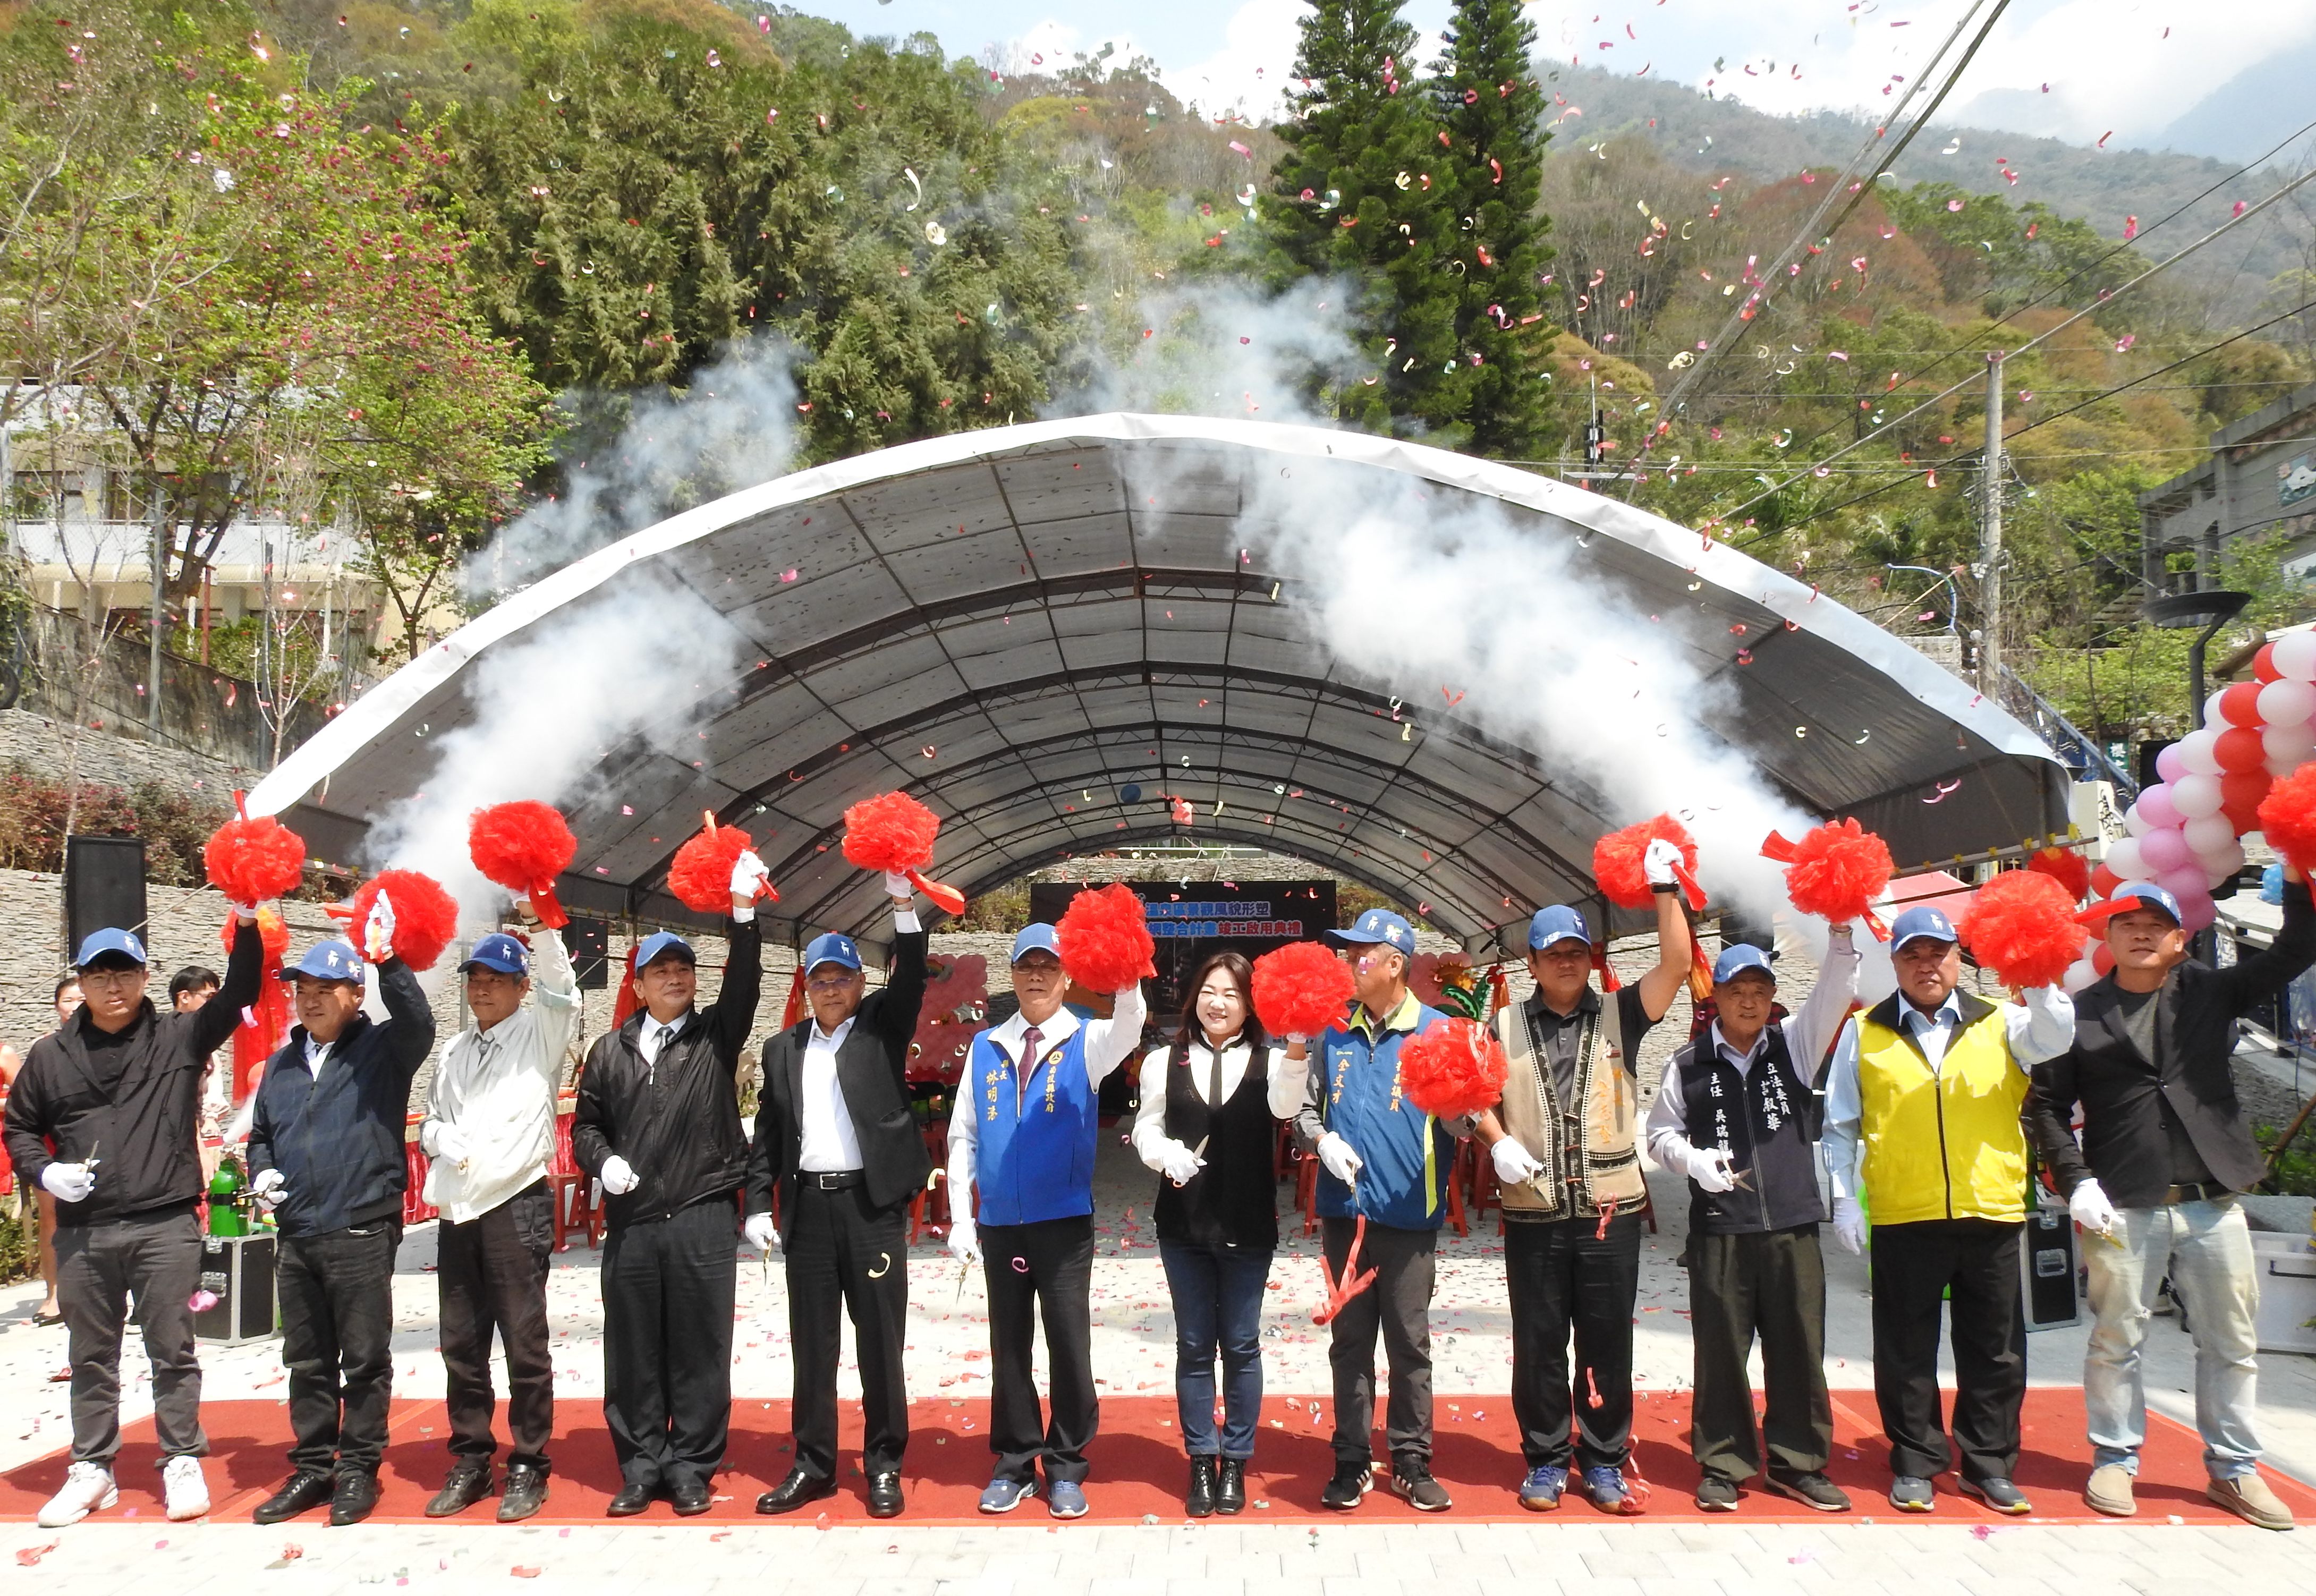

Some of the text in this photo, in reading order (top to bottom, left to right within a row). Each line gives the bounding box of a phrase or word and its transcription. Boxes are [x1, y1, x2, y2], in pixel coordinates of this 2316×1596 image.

[1710, 1072, 1723, 1097] 主任
[1767, 1063, 1792, 1115] 立法委員
